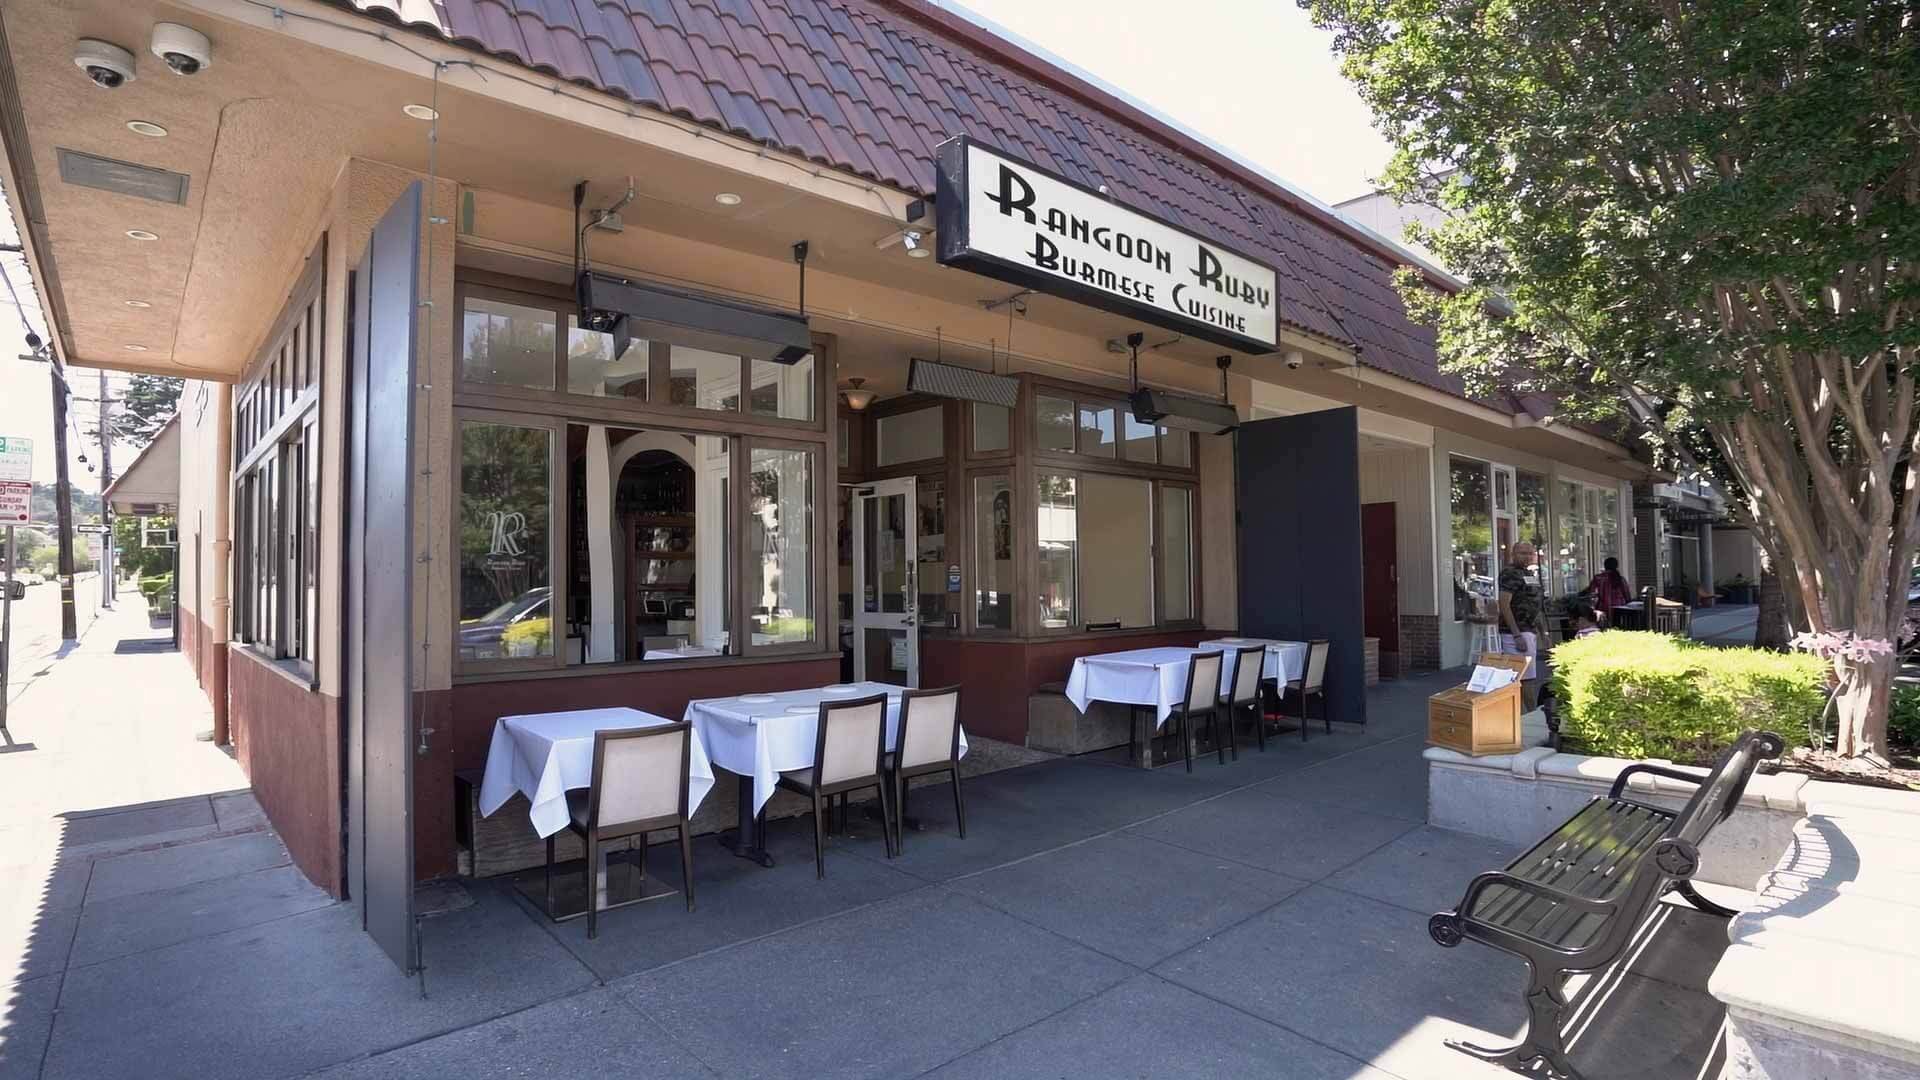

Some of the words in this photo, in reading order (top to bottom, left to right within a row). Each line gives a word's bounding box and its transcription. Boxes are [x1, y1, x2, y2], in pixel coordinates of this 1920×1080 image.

[984, 163, 1172, 274] RANGOON
[1189, 244, 1270, 309] RUBY
[1026, 232, 1155, 303] BURMESE
[1172, 283, 1247, 333] CUISINE
